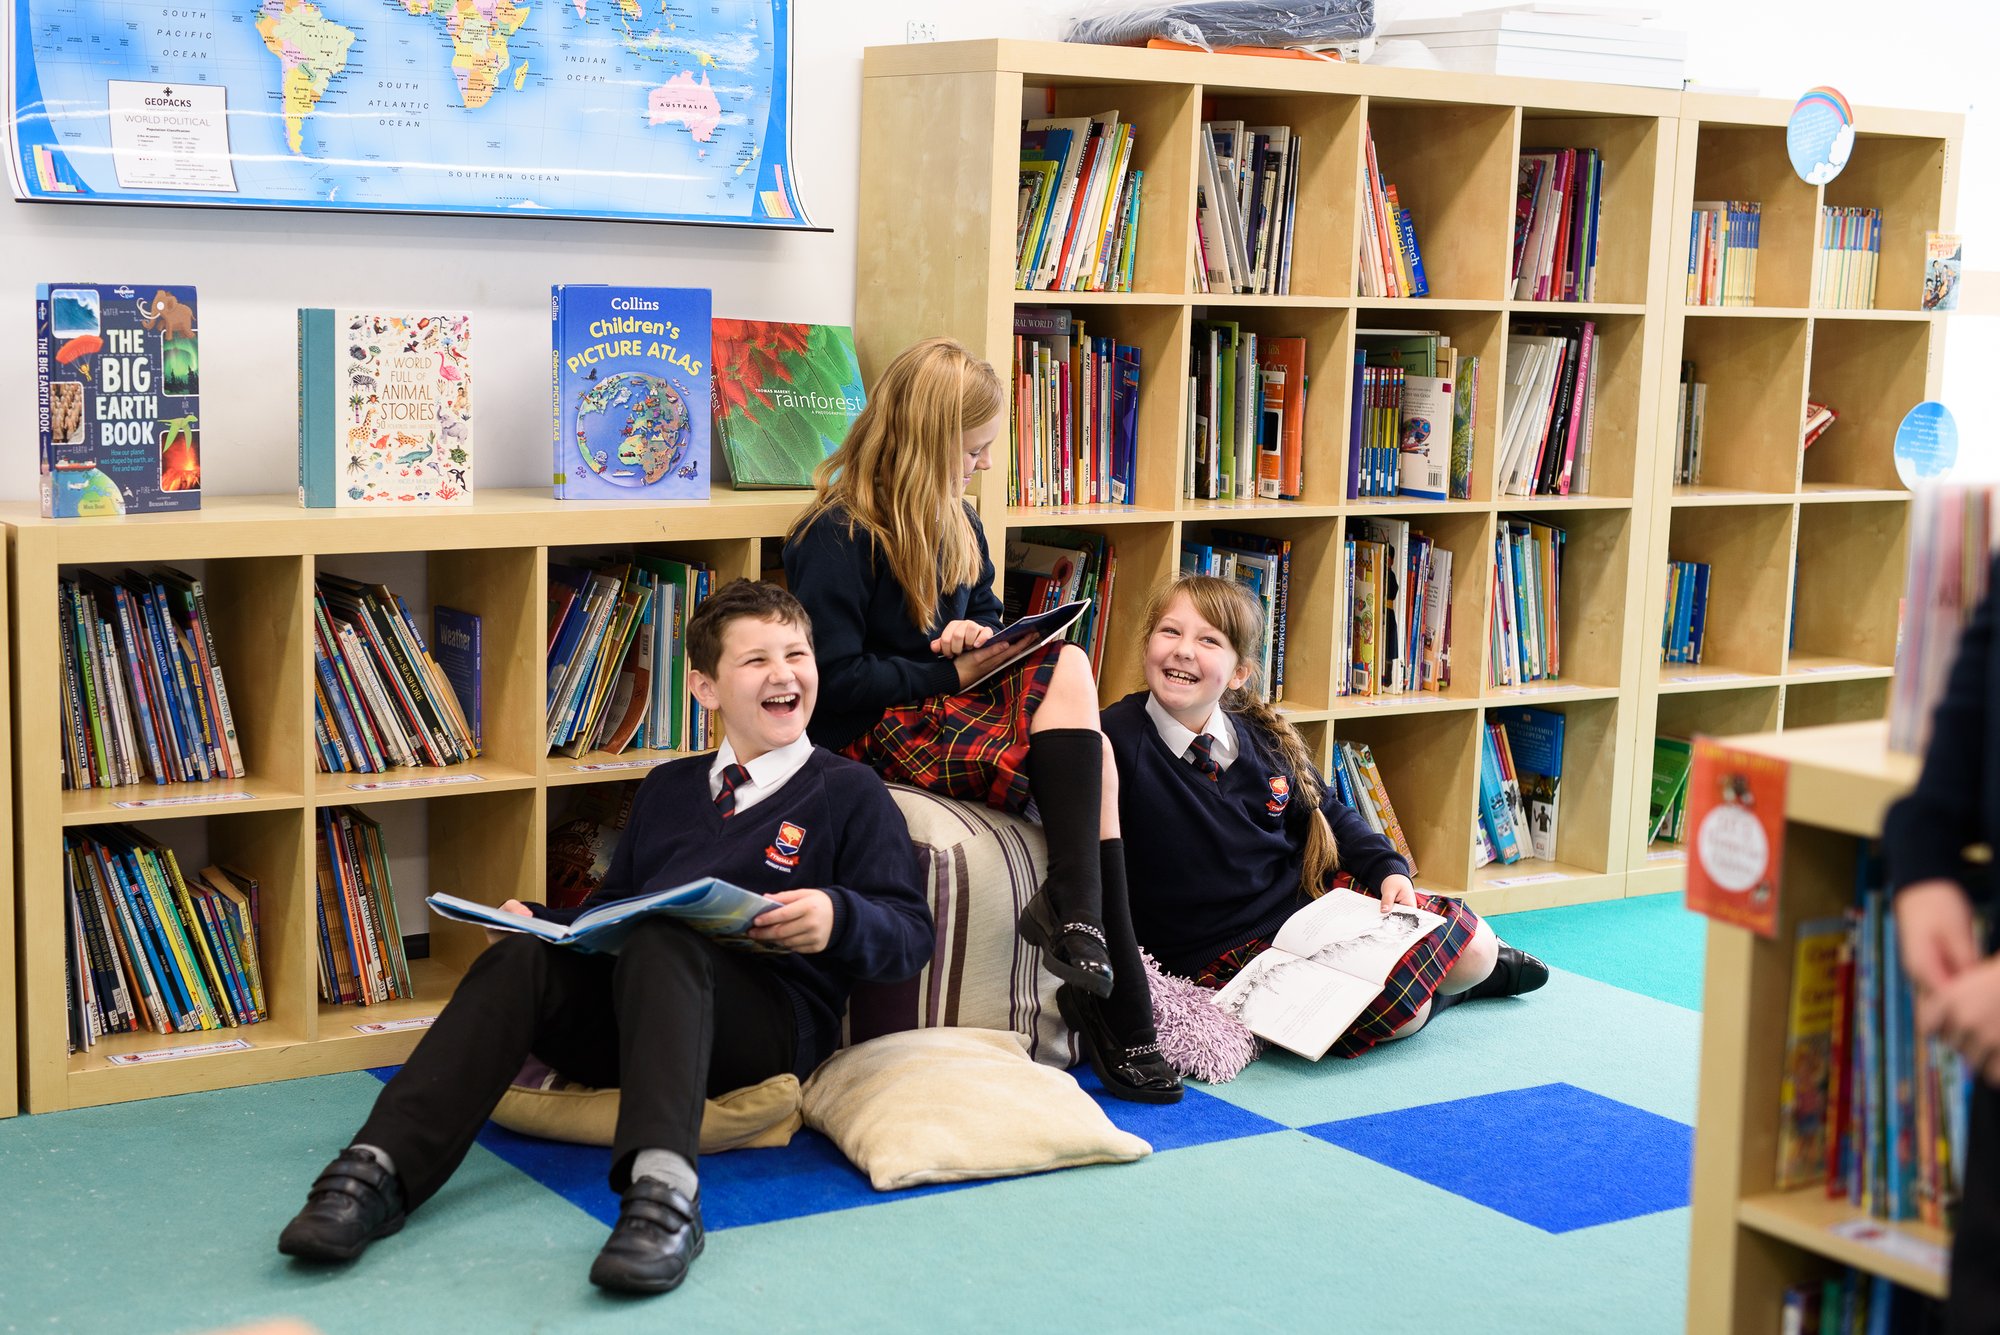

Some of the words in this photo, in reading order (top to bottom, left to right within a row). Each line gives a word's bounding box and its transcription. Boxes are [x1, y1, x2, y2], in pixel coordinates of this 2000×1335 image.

[162, 9, 207, 19] SOUTH
[157, 29, 213, 40] PACIFIC
[163, 50, 208, 59] OCEAN
[565, 56, 607, 64] INDIAN
[378, 81, 419, 90] SOUTH
[145, 97, 192, 107] GEOPACKS
[368, 100, 430, 110] ATLANTIC
[125, 115, 160, 124] WORLD
[163, 116, 210, 127] POLITICAL
[379, 119, 421, 128] OCEAN
[448, 171, 514, 180] SOUTHERN
[521, 173, 561, 182] OCEAN
[1391, 211, 1408, 254] French
[1403, 224, 1421, 266] French
[102, 308, 119, 317] WATER
[551, 295, 559, 321] Collins
[611, 297, 659, 311] Collins
[589, 316, 680, 340] Children's
[1028, 319, 1054, 329] WORLD
[37, 336, 48, 355] THE
[106, 328, 145, 354] THE
[37, 356, 48, 373] BIG
[394, 357, 432, 370] WORLD
[551, 349, 559, 384] Children's
[566, 340, 642, 374] PICTURE
[647, 341, 703, 377] ATLAS
[101, 356, 152, 393] BIG
[390, 370, 413, 383] FULL
[417, 371, 426, 381] OF
[37, 374, 49, 405] EARTH
[382, 384, 433, 401] ANIMAL
[552, 384, 560, 416] PICTURE
[776, 391, 863, 412] rainforest
[1559, 384, 1569, 413] LENNON
[1572, 371, 1586, 417] COMPOSERS
[38, 406, 49, 433] BOOK
[96, 395, 158, 421] EARTH
[380, 402, 435, 421] STORIES
[101, 421, 155, 447] BOOK
[376, 419, 385, 429] 50
[552, 418, 560, 441] ATLAS
[72, 445, 88, 455] EARTH
[1281, 560, 1289, 573] 100
[73, 588, 82, 605] COOL
[1279, 574, 1288, 613] SCIENTISTS
[118, 607, 130, 630] EARTH
[196, 596, 211, 633] EYEWITNESS
[207, 642, 219, 665] GUIDES
[406, 617, 416, 630] LOOK
[593, 621, 603, 636] PRESS
[1272, 608, 1280, 644] PEAKE
[1278, 613, 1286, 632] WHO
[385, 635, 398, 651] Secrets
[440, 622, 470, 651] Weather
[1277, 632, 1285, 652] MADE
[155, 639, 169, 676] VOLCANOES
[198, 645, 207, 663] Rocks
[392, 648, 402, 657] of
[395, 654, 405, 665] the
[318, 658, 334, 687] ISLANDS
[1275, 653, 1284, 682] HISTORY
[82, 650, 94, 687] PLANET
[89, 688, 100, 718] EARTH
[399, 662, 424, 702] SEASHORE
[212, 667, 224, 688] ROCK
[218, 694, 233, 727] MINERAL
[68, 668, 78, 708] GROUND?
[73, 709, 81, 733] ANITA
[77, 734, 86, 766] GANERI
[1341, 778, 1354, 805] OXFORD
[345, 828, 358, 864] EYEWITNESS
[354, 872, 365, 895] GUIDES
[86, 863, 100, 895] ANCIENT
[95, 895, 106, 915] EGYPT
[139, 860, 152, 884] ANCIENT
[148, 883, 159, 900] EGYPT
[108, 869, 125, 902] ANCIENT
[120, 902, 132, 921] EGYPT
[366, 890, 375, 908] GREEK
[85, 920, 94, 930] OF
[94, 919, 102, 929] OF
[129, 900, 145, 930] MUMMIES
[145, 899, 161, 929] MUMMIES
[317, 905, 328, 937] MYTHOLOGY
[370, 908, 381, 934] WARRIOR
[96, 928, 108, 953] ANCIENT
[171, 922, 181, 939] Ancient
[177, 938, 186, 952] Egypt
[352, 923, 361, 944] GREAT
[360, 898, 373, 931] ANCIENT
[367, 931, 380, 961] GREECE
[88, 929, 100, 955] ANCIENT
[209, 928, 221, 948] AWFUL
[215, 947, 231, 975] EGYPTIANS
[222, 927, 234, 947] AWFUL
[228, 945, 243, 974] EGYPTIANS
[94, 954, 105, 973] EGYPT
[102, 952, 113, 972] EGYPT
